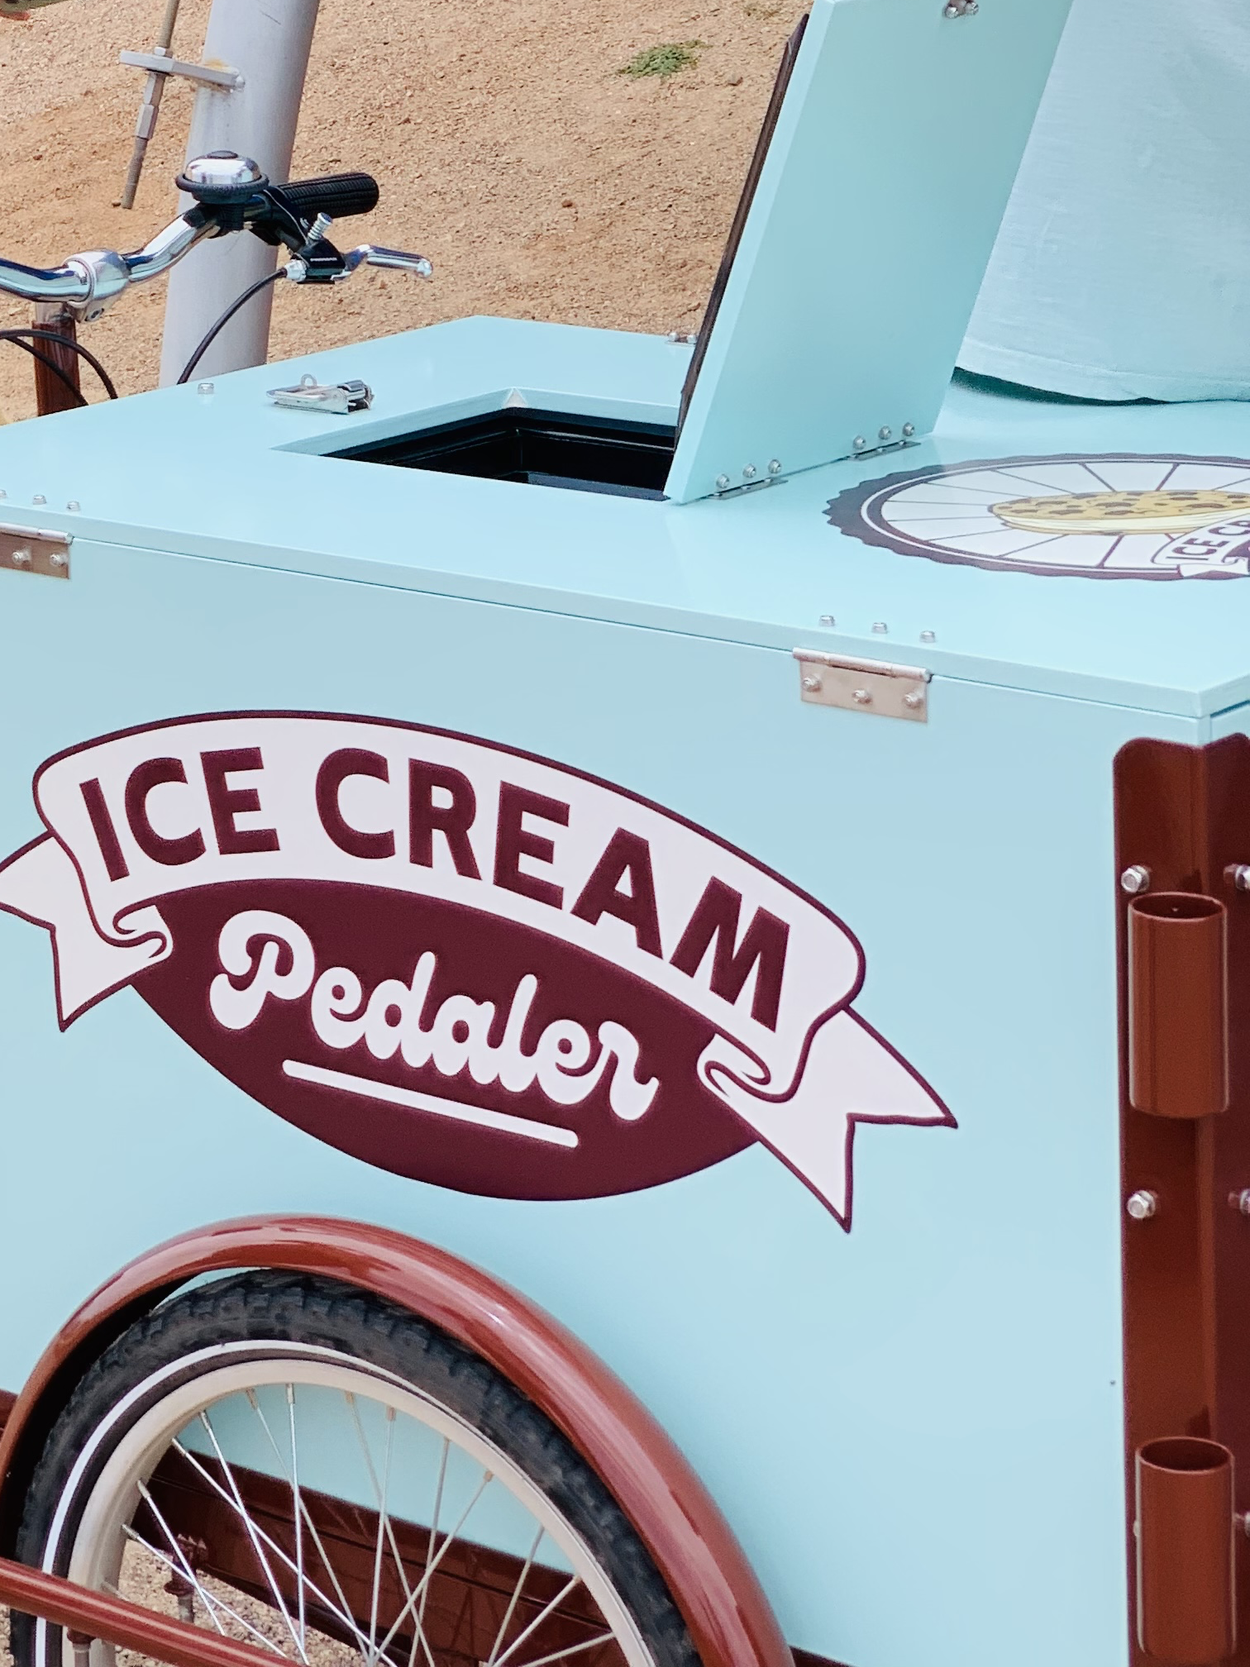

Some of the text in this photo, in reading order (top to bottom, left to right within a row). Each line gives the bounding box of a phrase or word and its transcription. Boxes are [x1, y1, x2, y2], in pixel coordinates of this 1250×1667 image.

[1165, 537, 1231, 562] ICE
[80, 746, 791, 1033] ICE CREAM
[209, 909, 660, 1122] Pedaler
